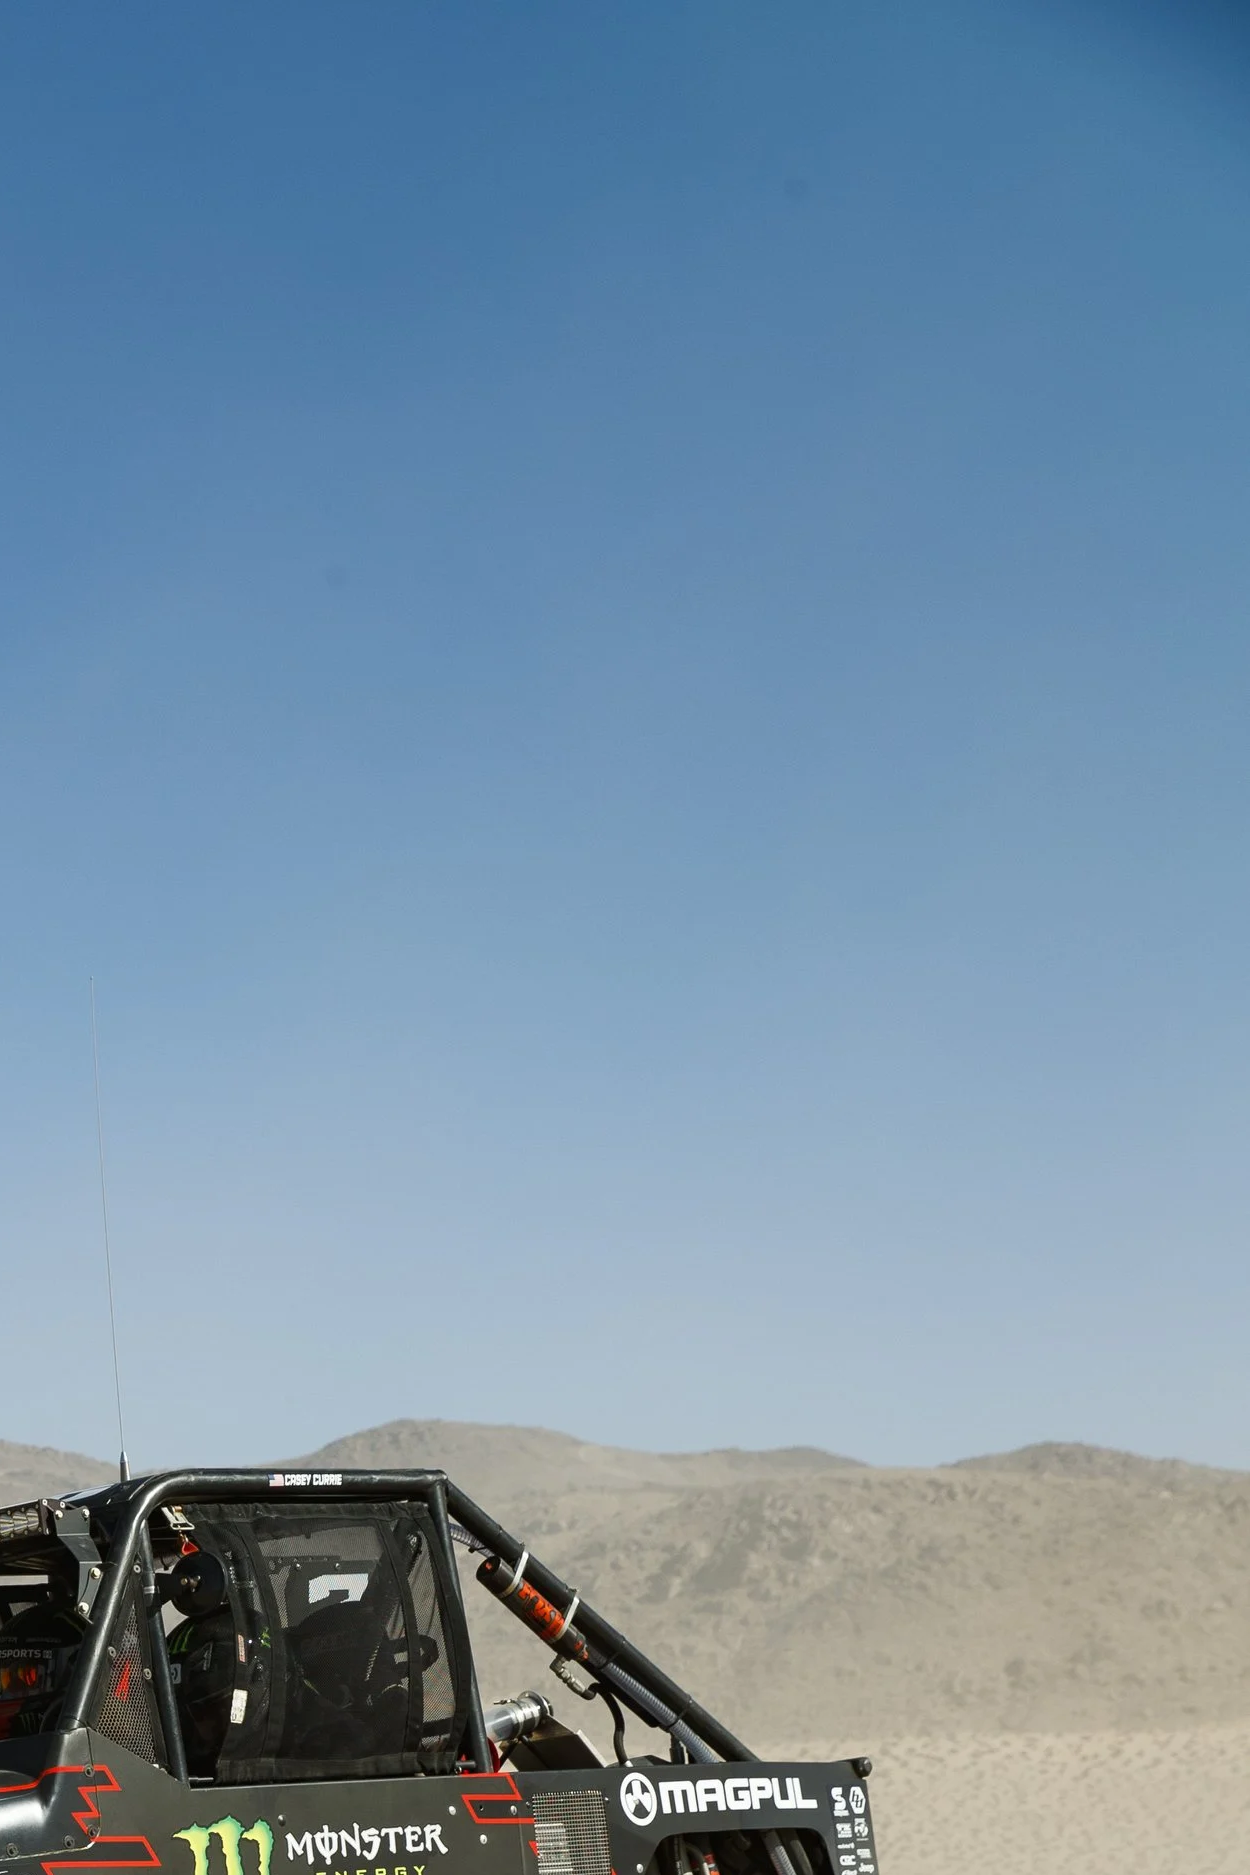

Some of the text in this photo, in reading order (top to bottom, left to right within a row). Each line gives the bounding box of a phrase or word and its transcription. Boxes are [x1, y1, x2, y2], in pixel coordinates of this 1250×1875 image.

[284, 1474, 343, 1486] CASEY CURRIE
[658, 1777, 818, 1814] MAGPUL
